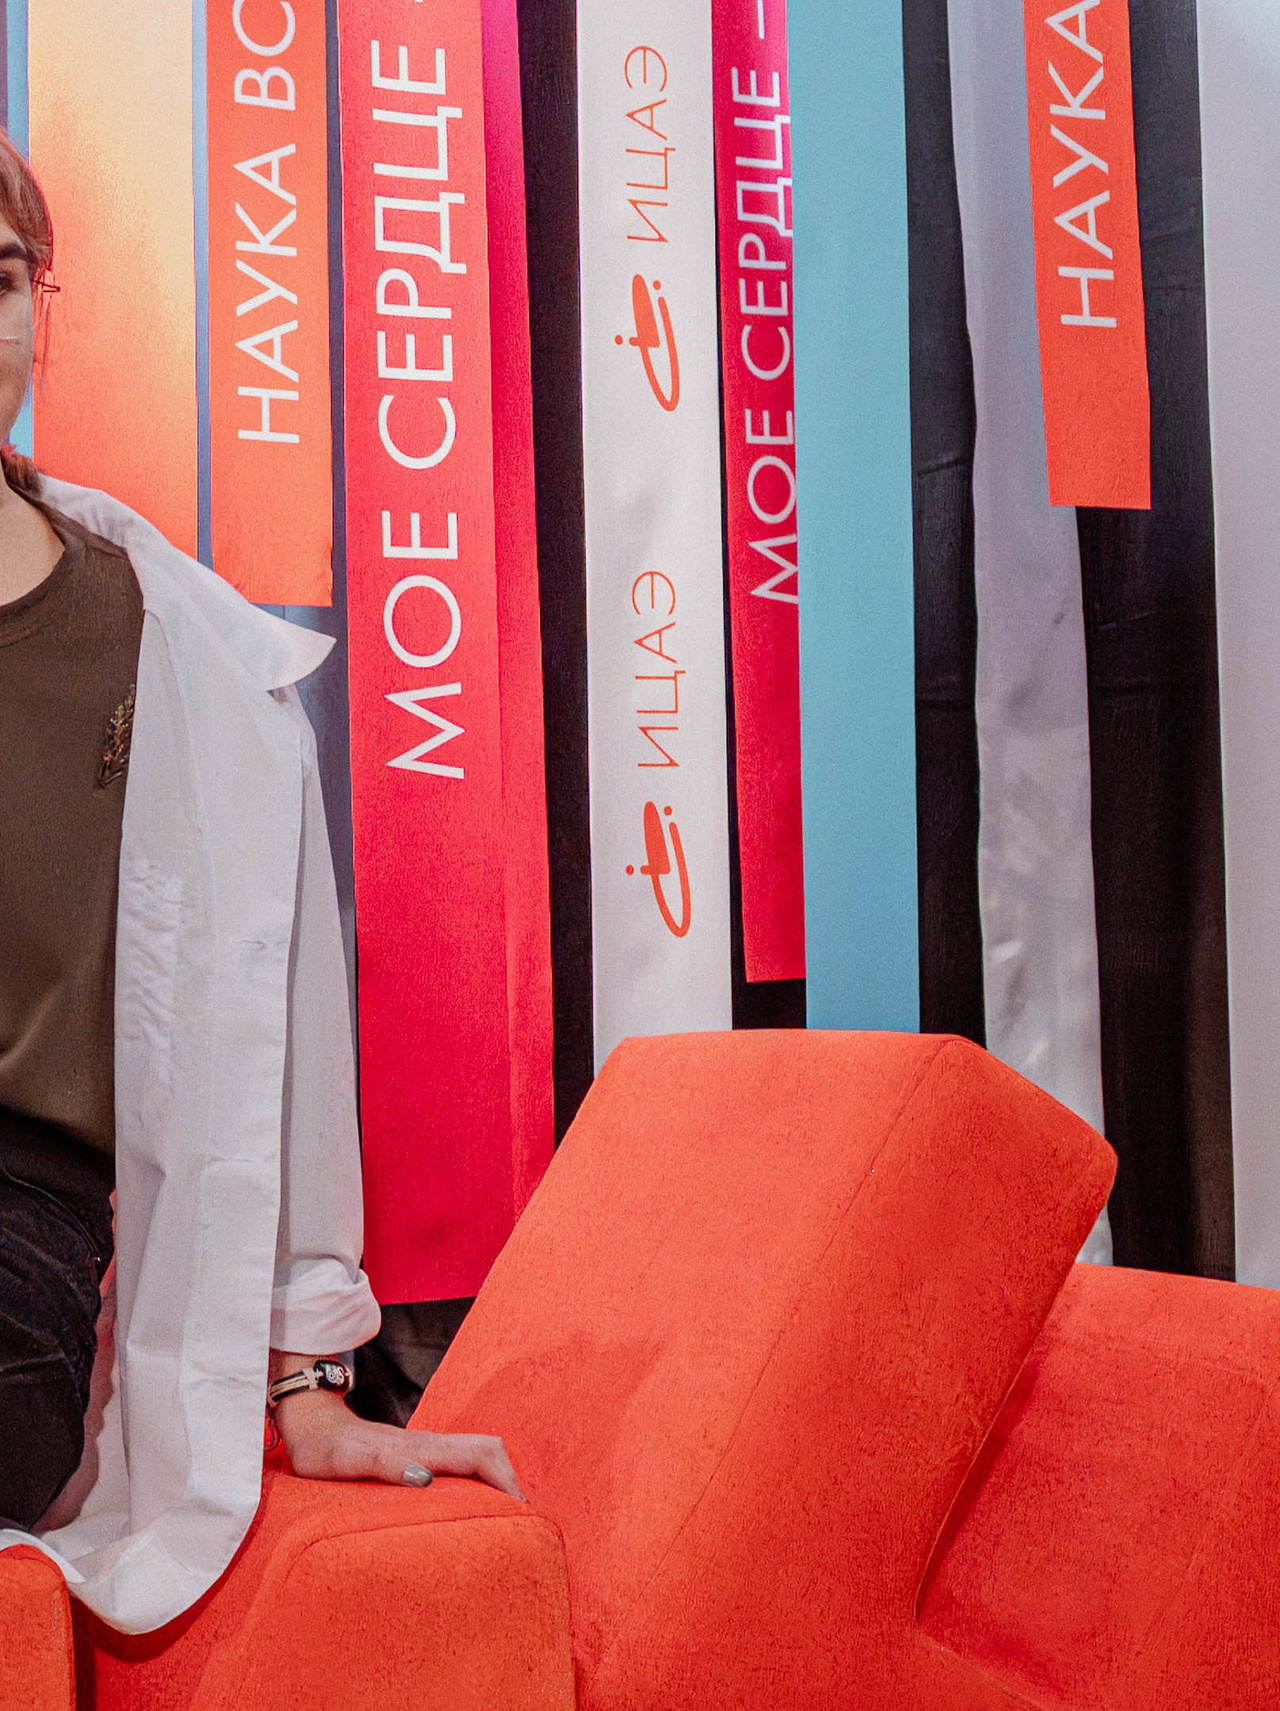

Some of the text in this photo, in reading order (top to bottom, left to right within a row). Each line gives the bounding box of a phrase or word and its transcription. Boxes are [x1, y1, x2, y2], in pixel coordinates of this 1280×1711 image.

[232, 143, 300, 444] НАУКА
[624, 46, 676, 243] ИЦАЭ
[731, 67, 793, 380] СЕРДЦЕ
[1044, 0, 1117, 328] НАУКА
[371, 40, 468, 780] МОЕ СЕРДЦЕ
[745, 408, 799, 604] МОЕ
[631, 571, 686, 768] ИЦАЭ
